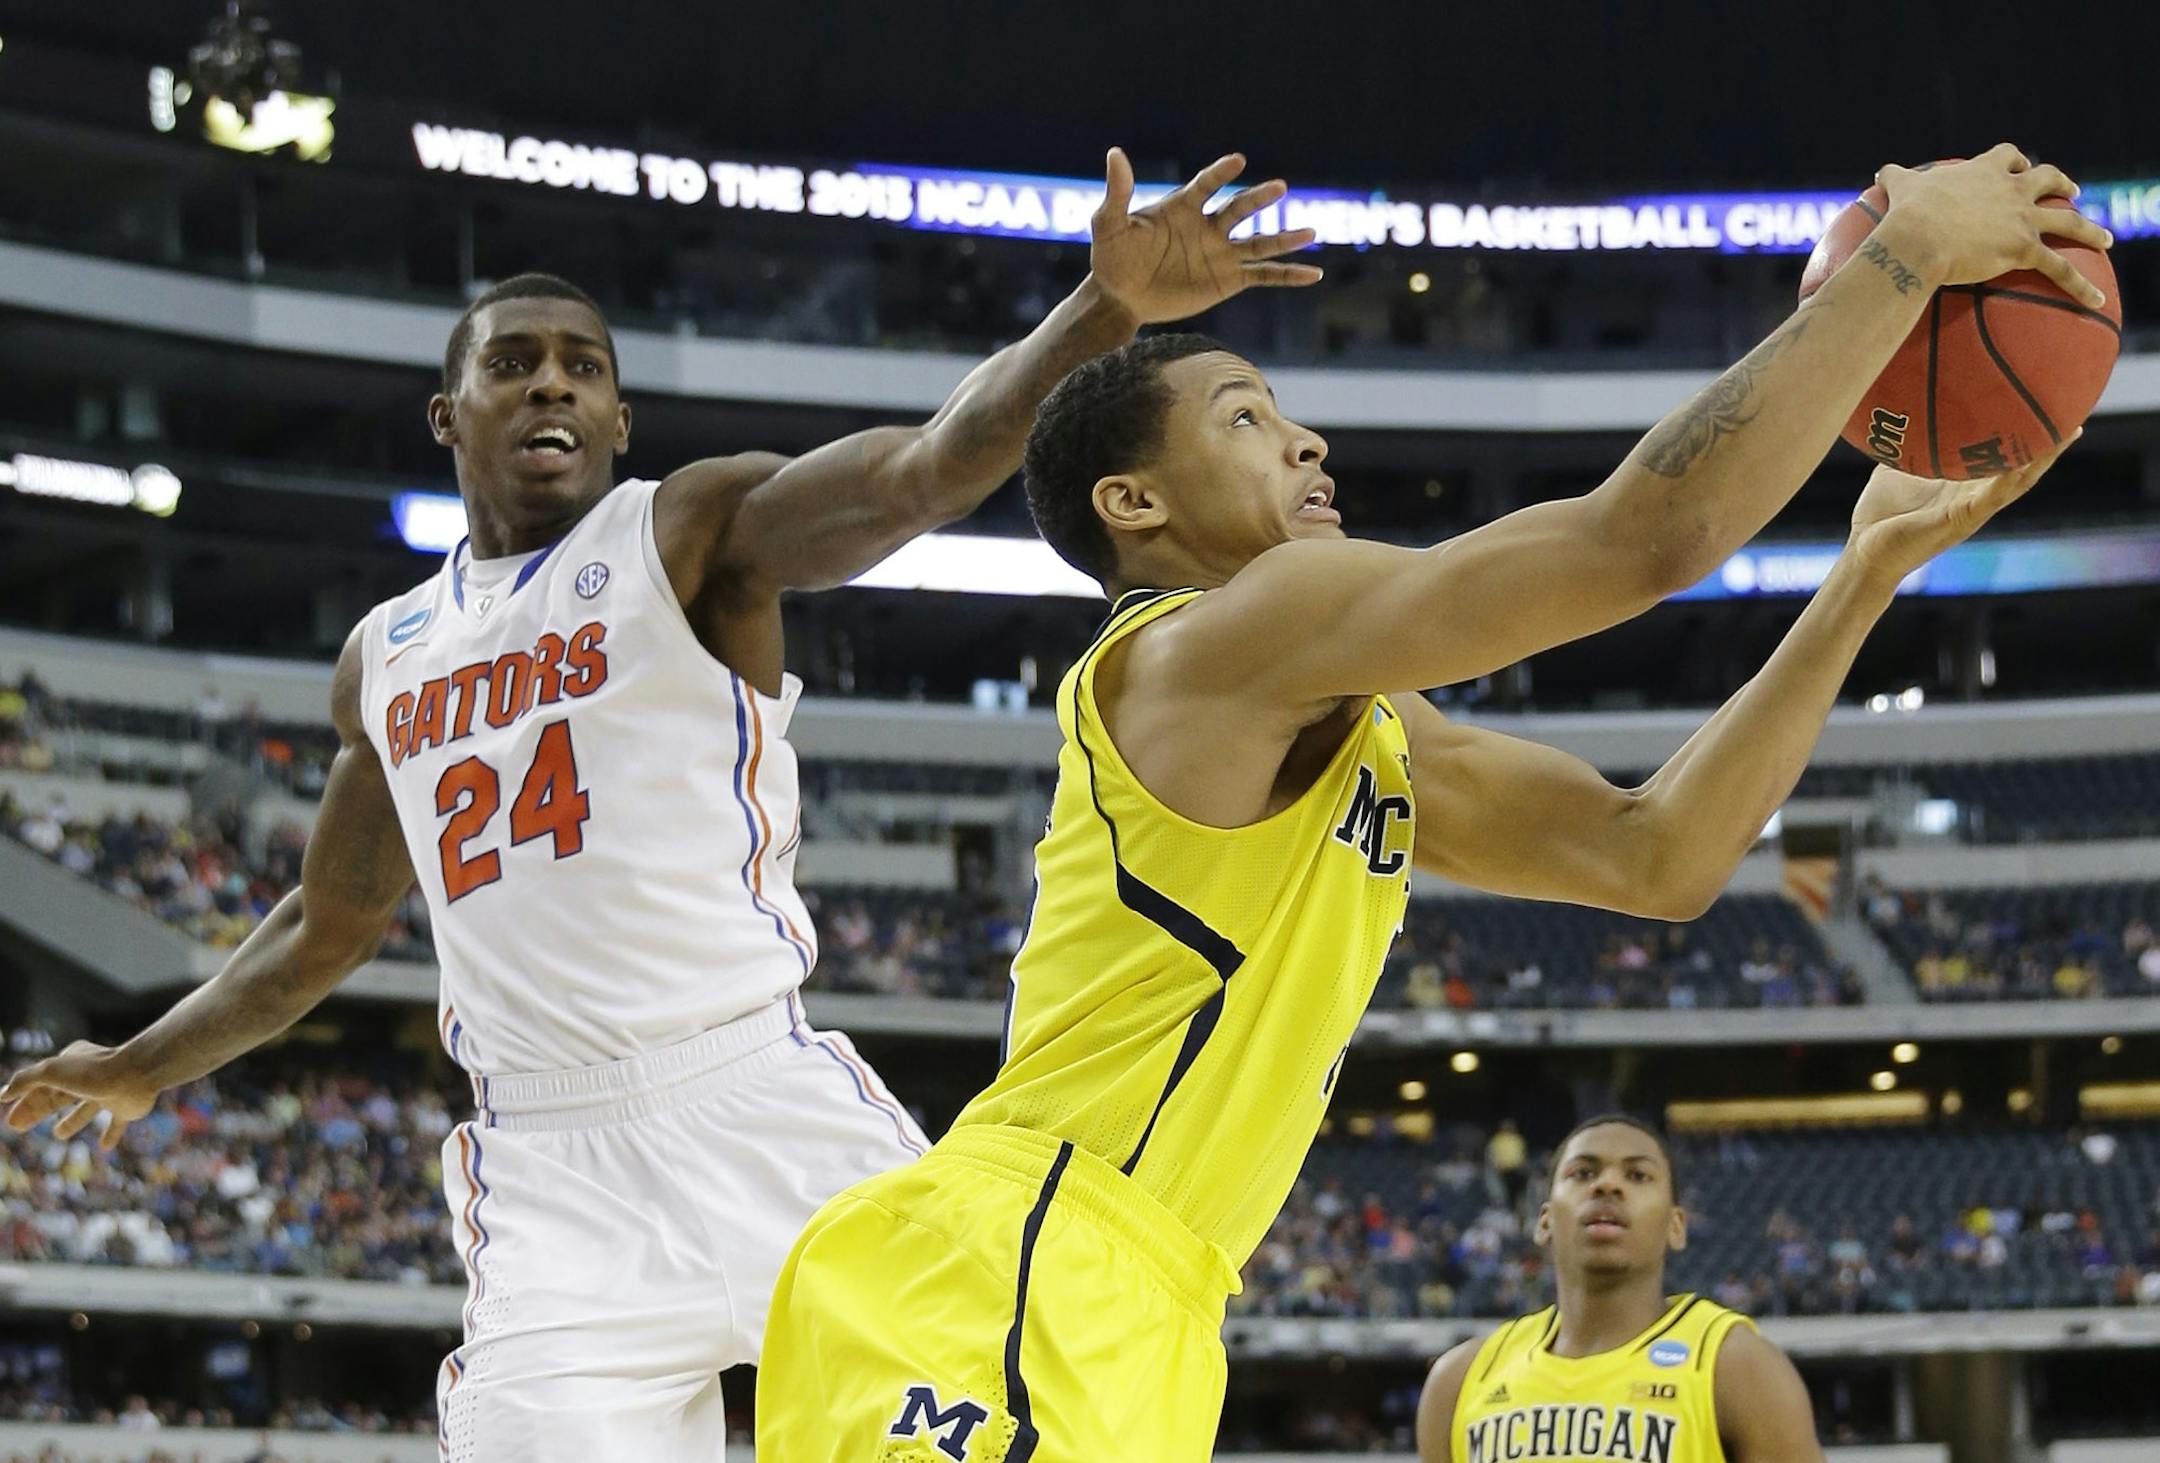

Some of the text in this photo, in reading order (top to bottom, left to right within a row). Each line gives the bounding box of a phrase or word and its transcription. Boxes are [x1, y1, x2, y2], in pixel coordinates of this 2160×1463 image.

[411, 122, 639, 196] WELCOME
[640, 153, 708, 204] TO
[708, 161, 805, 213] THE
[807, 169, 913, 221] 2013
[917, 178, 1049, 231] NCAA
[1286, 199, 1424, 246] MEN'S
[1429, 203, 1721, 249] BASKETBALL
[577, 563, 609, 598] SEC
[386, 621, 608, 769] GATORS
[434, 718, 590, 906] 24
[888, 1384, 990, 1463] M
[1467, 1404, 1678, 1463] MICHIGAN
